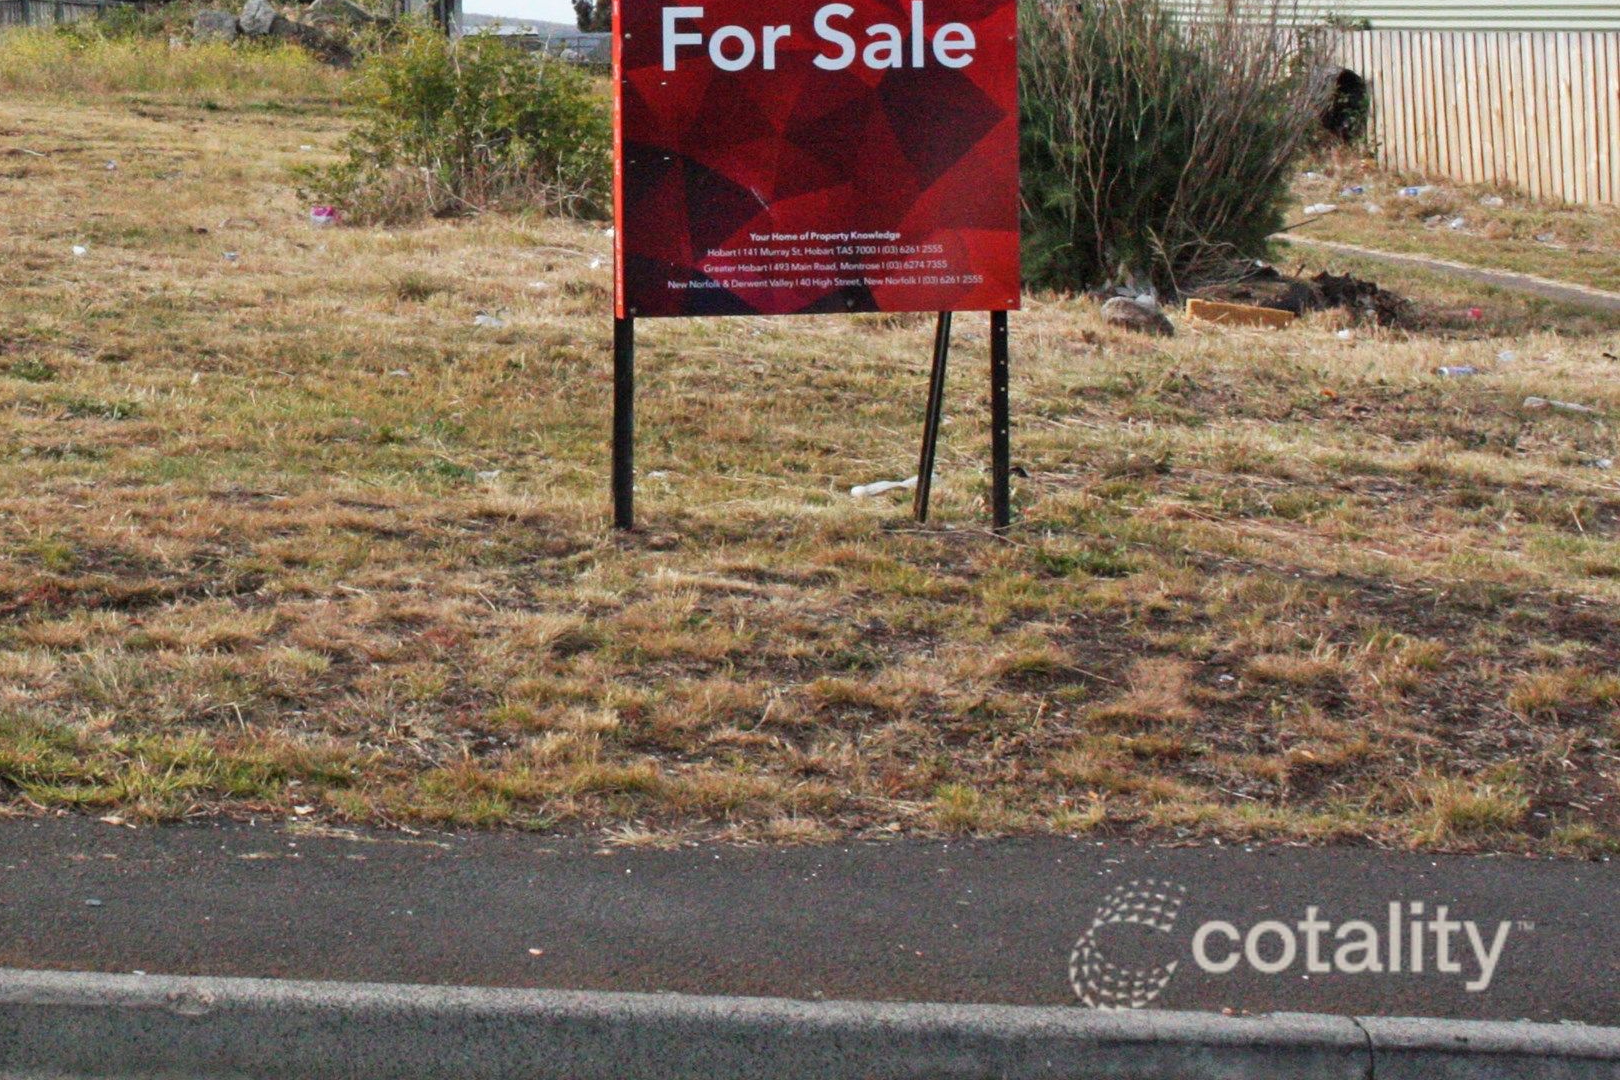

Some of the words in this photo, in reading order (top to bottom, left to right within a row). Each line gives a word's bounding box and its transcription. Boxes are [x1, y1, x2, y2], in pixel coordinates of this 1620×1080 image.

[662, 6, 791, 71] For
[812, 0, 976, 70] Sale
[750, 233, 769, 241] Your
[800, 232, 809, 240] of
[811, 232, 848, 241] Property
[851, 231, 901, 240] Knowledge
[708, 249, 737, 257] Hobart
[760, 249, 789, 257] Murray
[836, 246, 853, 254] TAS
[855, 246, 876, 254] 7000
[922, 245, 943, 253] 2555
[738, 264, 768, 272] Hobart
[840, 262, 880, 270] Montrose
[904, 261, 925, 269] 6274
[668, 281, 687, 289] New
[689, 280, 720, 288] Norfolk
[770, 279, 793, 288] Valley
[813, 278, 833, 288] High
[864, 277, 883, 285] New
[940, 276, 960, 284] 6261
